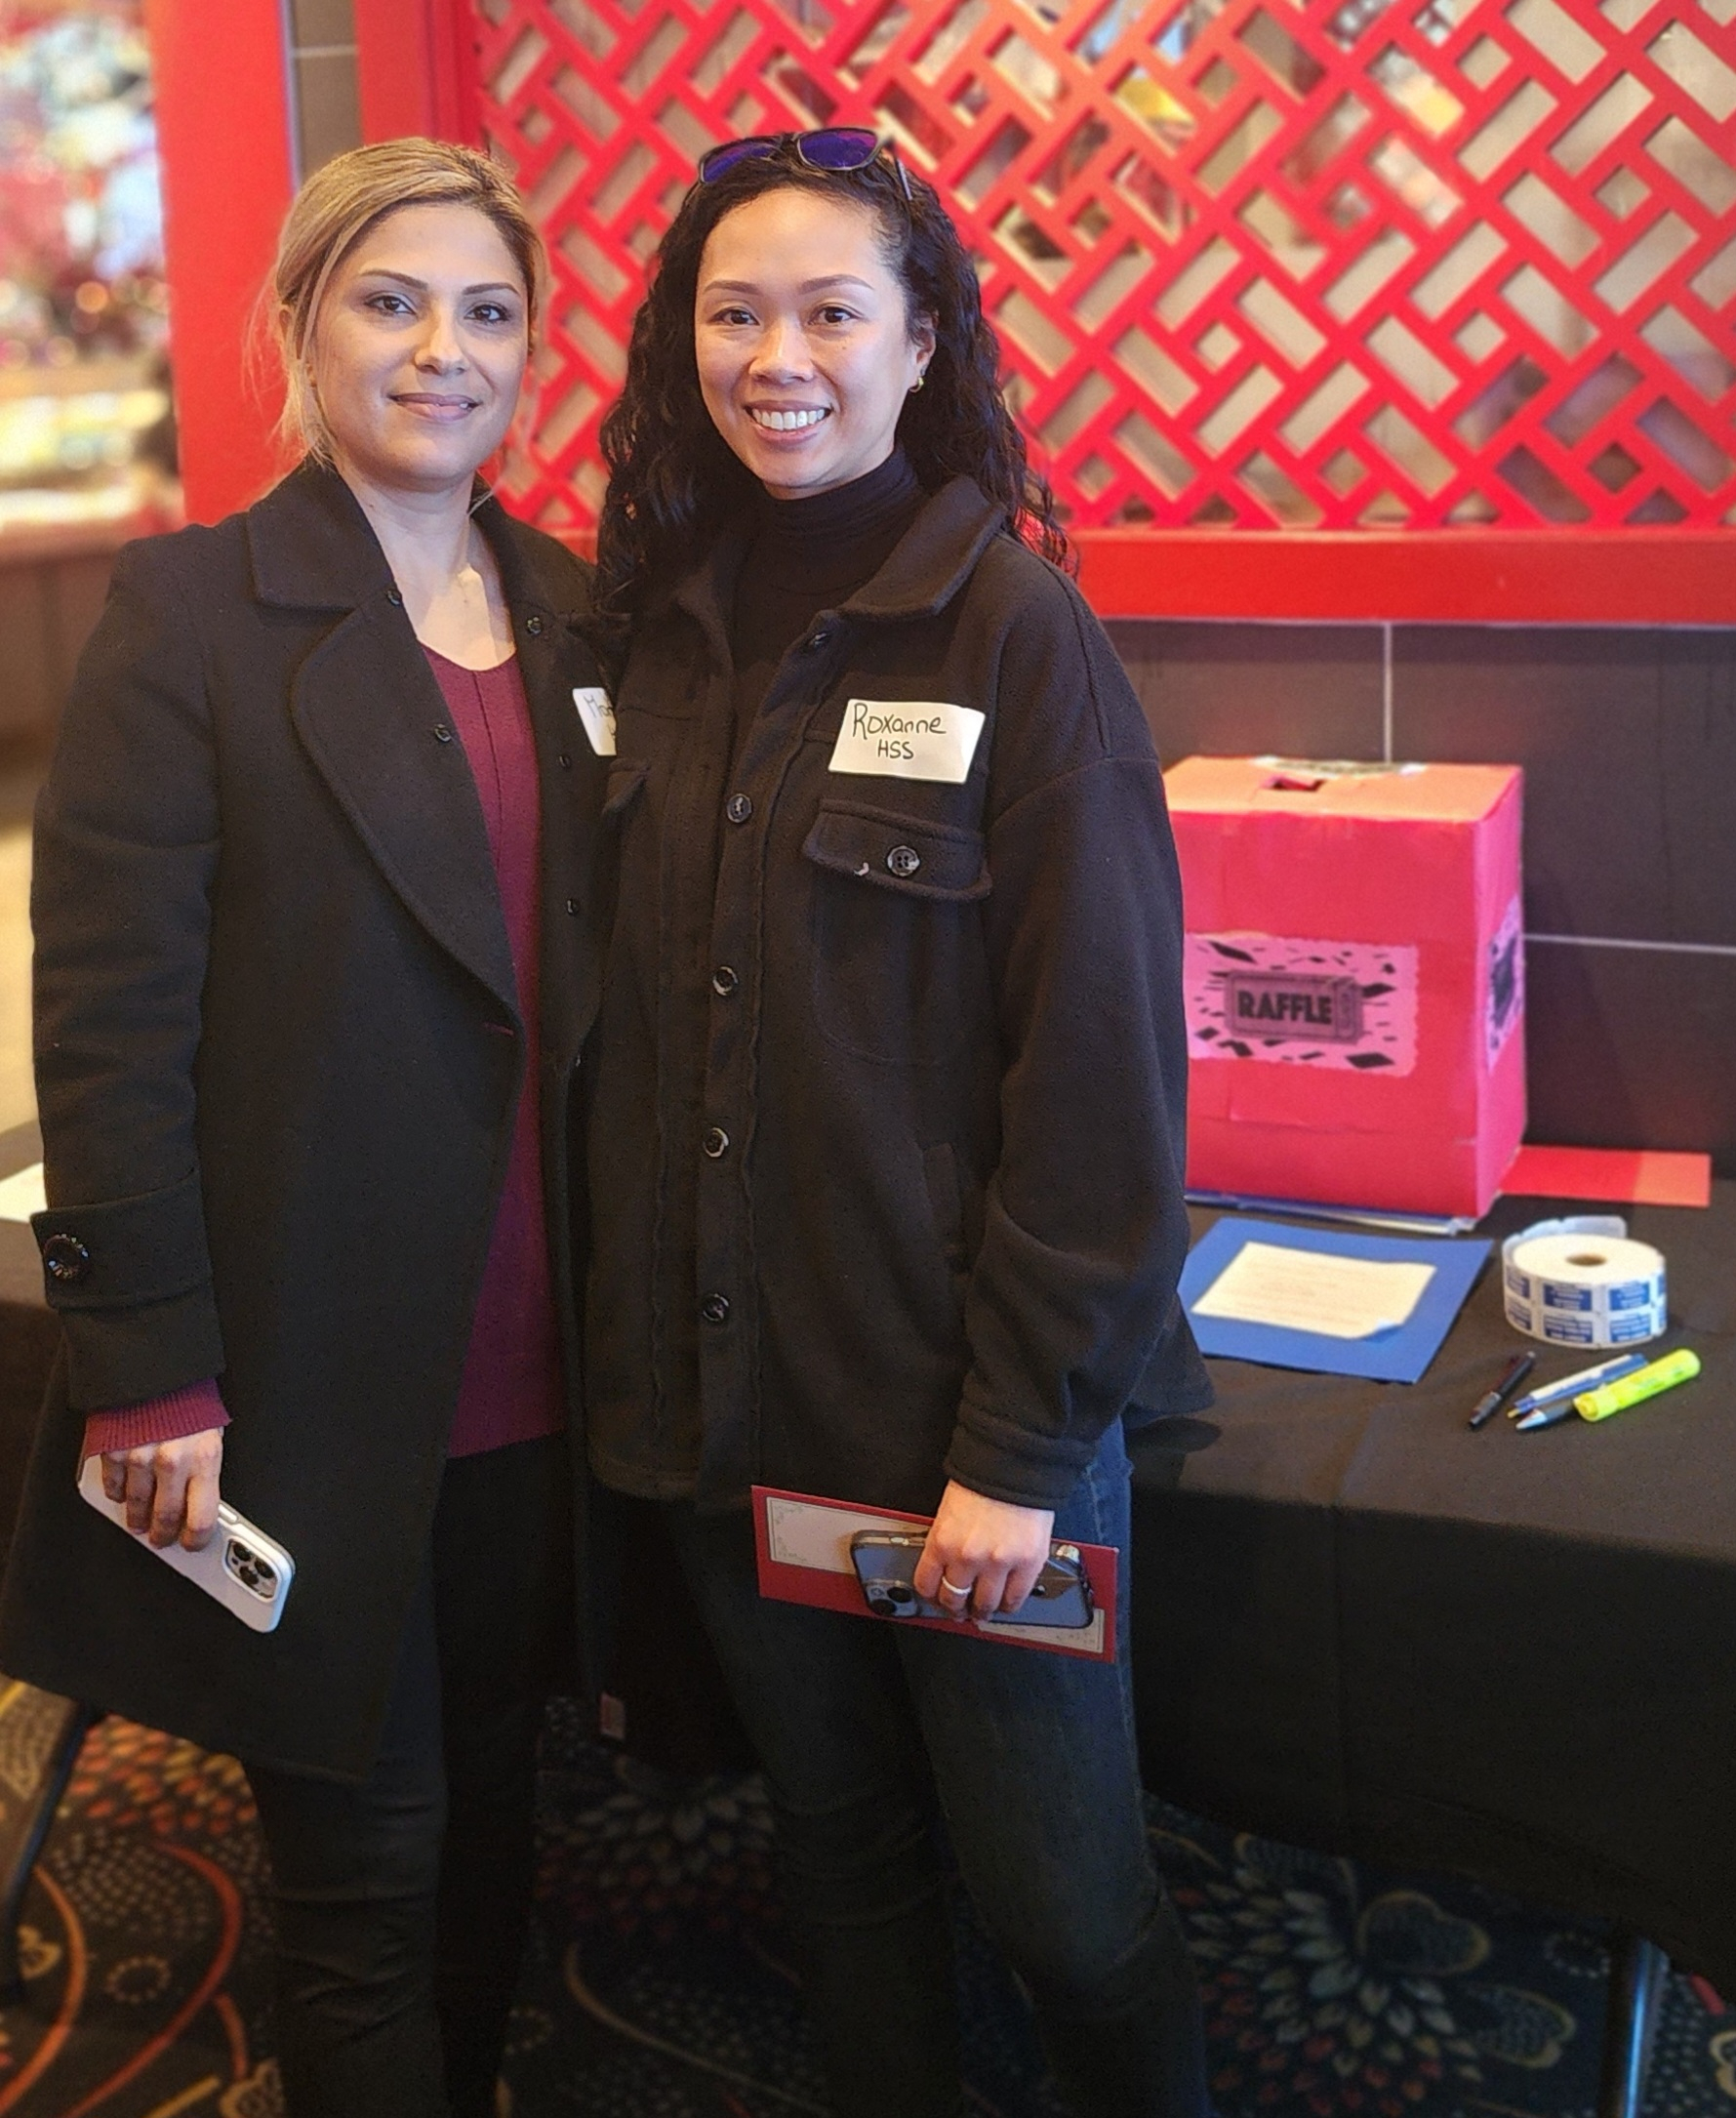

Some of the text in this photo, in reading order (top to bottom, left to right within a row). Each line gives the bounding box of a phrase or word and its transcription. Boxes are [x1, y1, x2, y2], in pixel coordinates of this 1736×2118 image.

[584, 694, 614, 718] Ma
[852, 702, 948, 740] Roxanne
[876, 738, 915, 759] HSS
[1236, 990, 1333, 1025] RAFFLE
